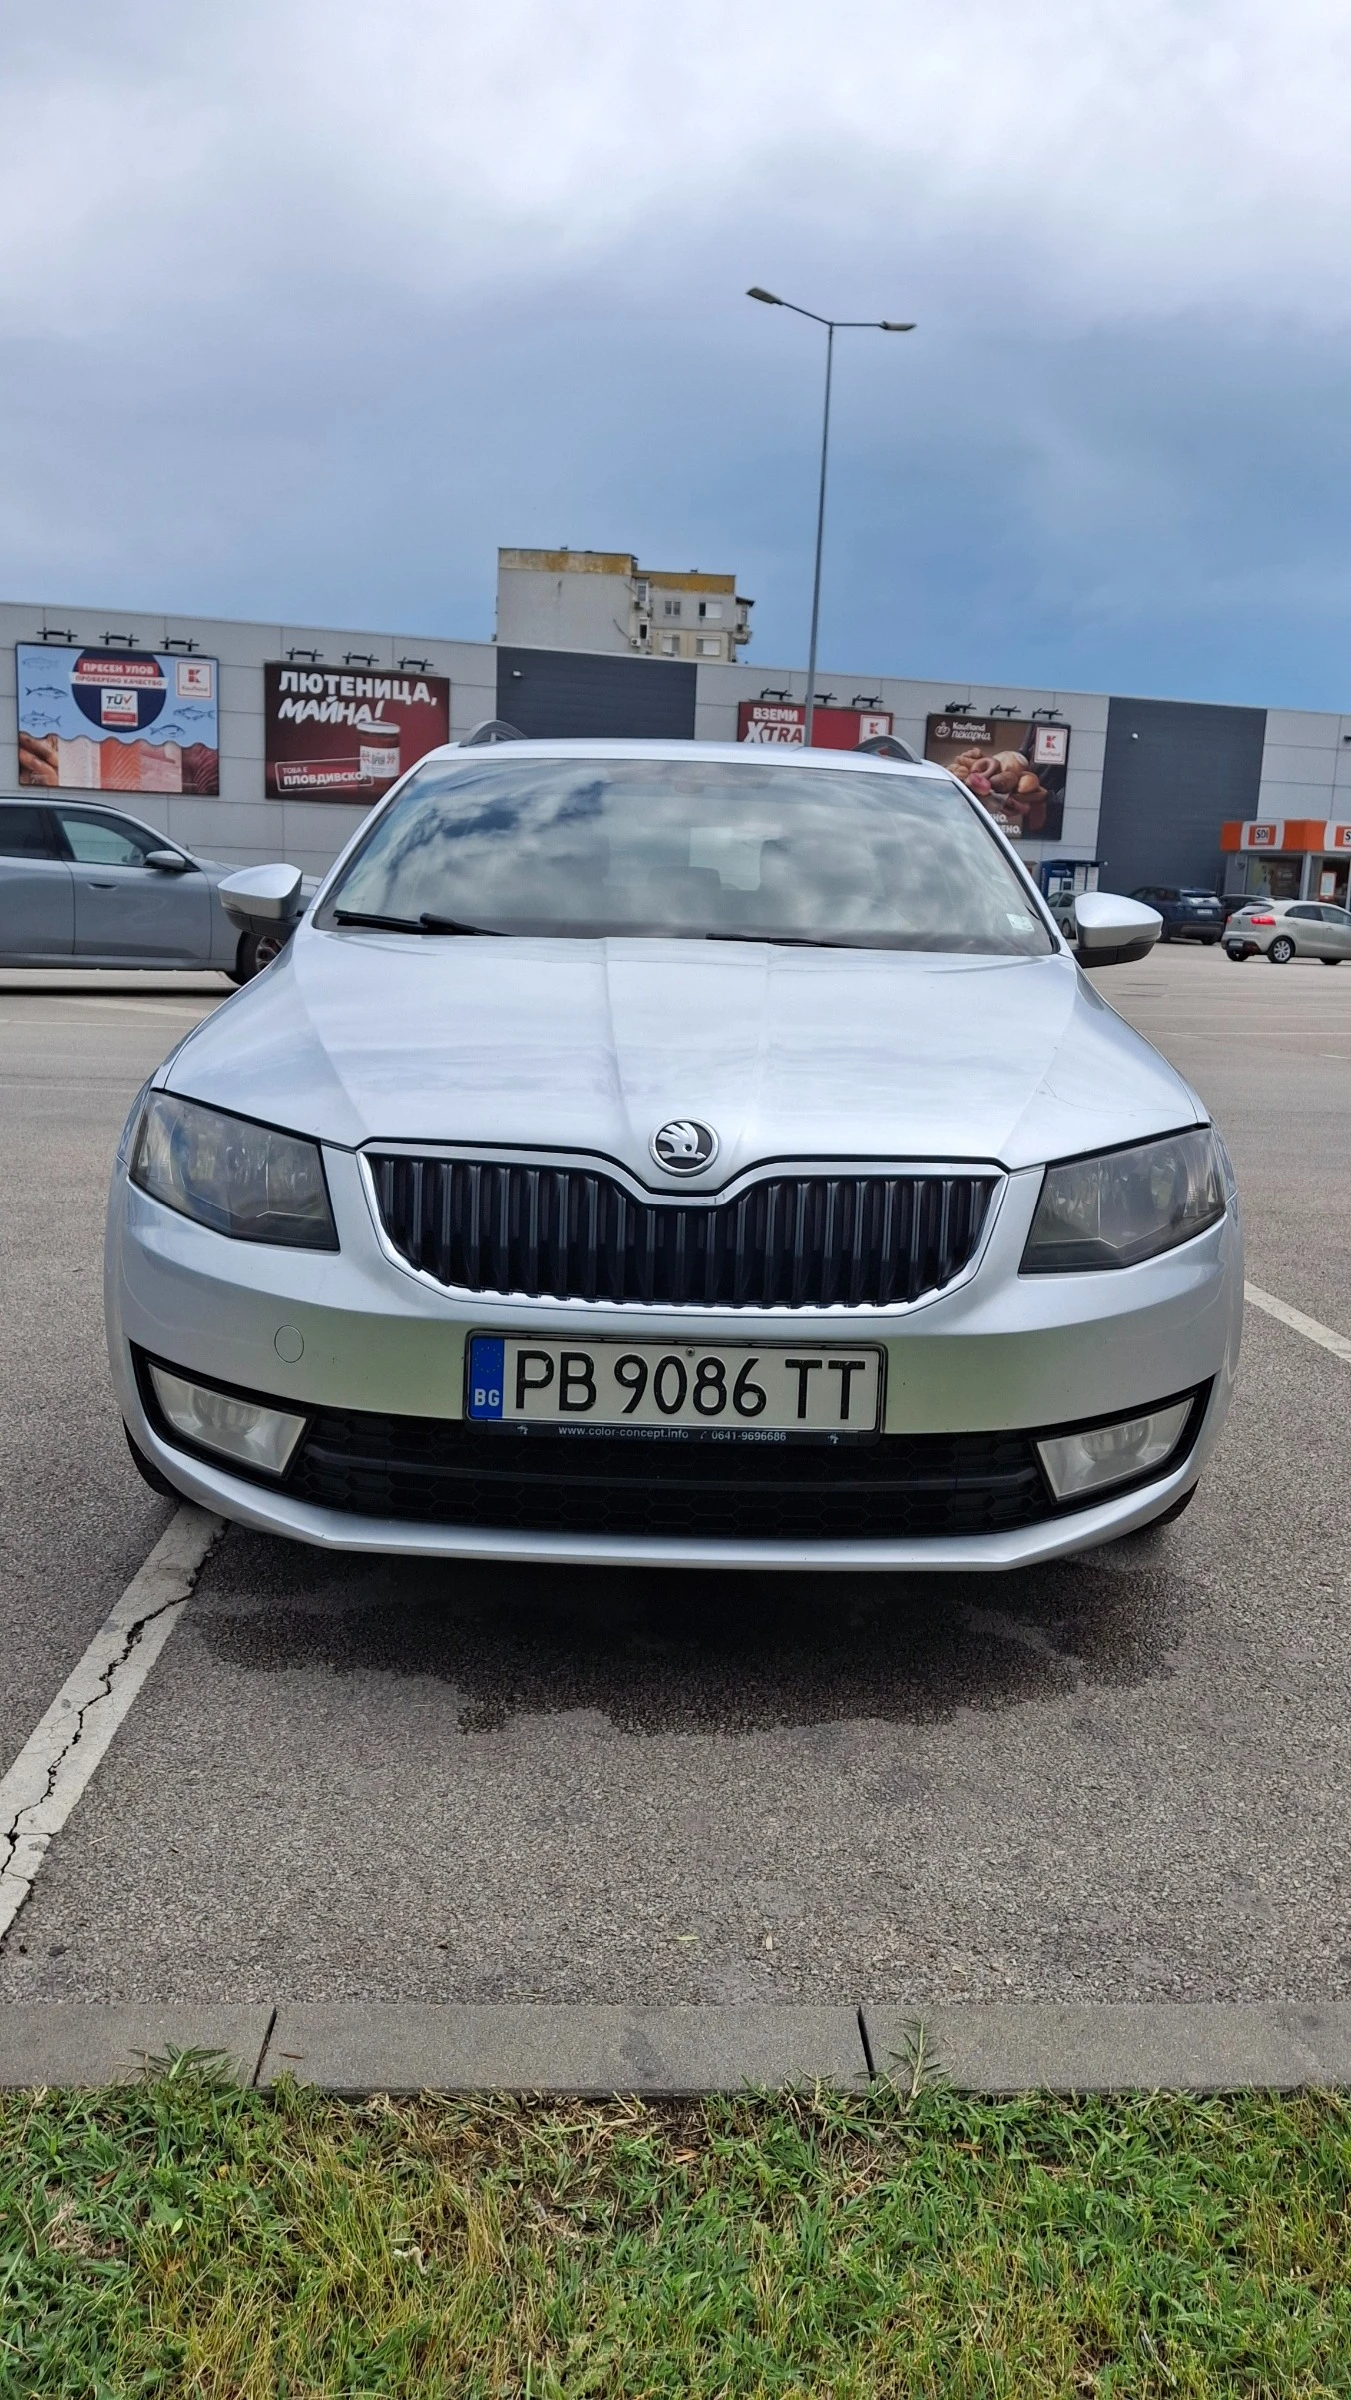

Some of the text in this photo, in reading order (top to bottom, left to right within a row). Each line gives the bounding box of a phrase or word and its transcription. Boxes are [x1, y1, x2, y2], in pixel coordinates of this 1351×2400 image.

[83, 662, 154, 675] ПРЕСЕН УЛОВ
[75, 675, 163, 686] ПРОВЕРЕНО КАЧЕСТВО
[279, 671, 437, 706] ЛЮТЕНИЦА,
[106, 693, 133, 705] TÜV
[278, 696, 385, 726] МАЙНА!
[752, 707, 798, 722] ВЗЕМИ
[743, 721, 803, 743] XTRA
[952, 721, 986, 731] Kaufland
[951, 730, 991, 742] пекарна
[515, 1350, 866, 1420] PB 9086 TT
[474, 1388, 500, 1407] BG
[558, 1426, 787, 1442] www.color-concept.info 0641-9696686
